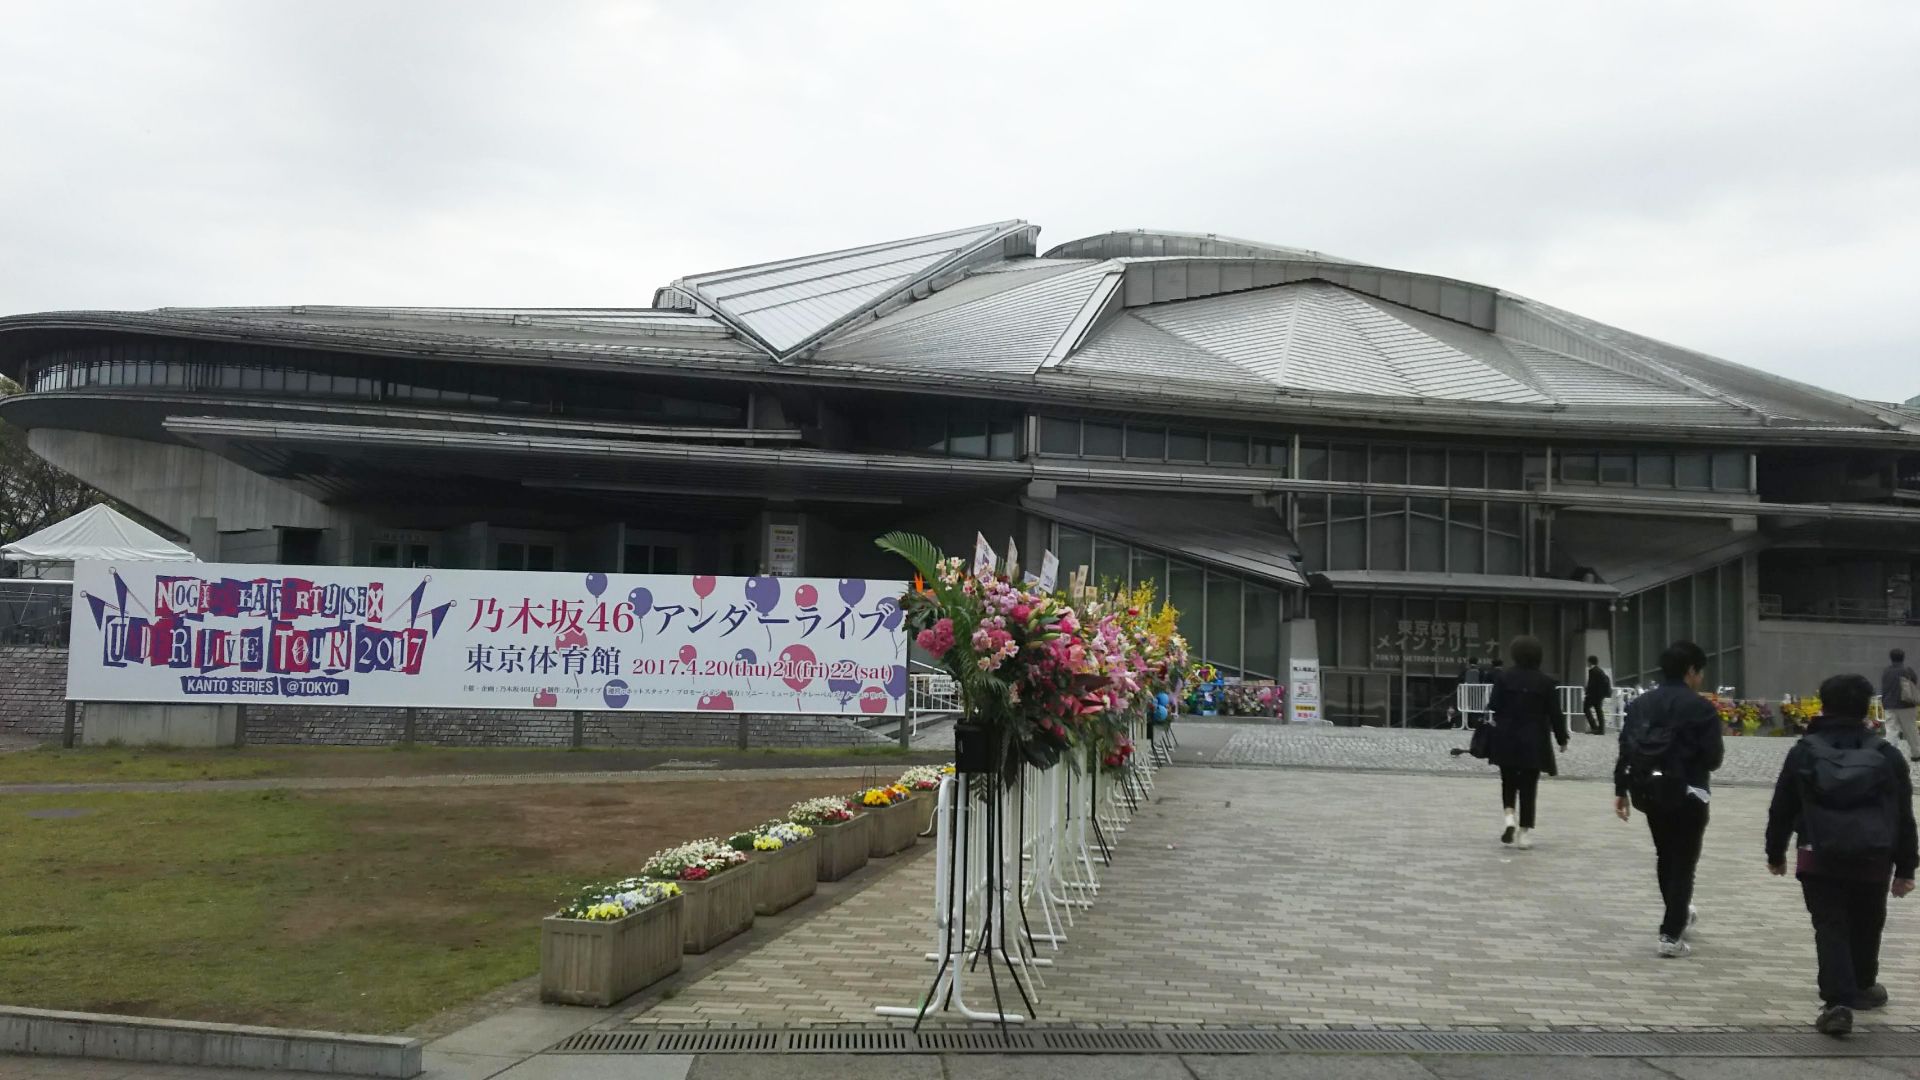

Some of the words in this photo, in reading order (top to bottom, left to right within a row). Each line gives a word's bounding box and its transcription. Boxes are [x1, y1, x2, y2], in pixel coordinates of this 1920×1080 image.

[466, 596, 635, 636] 乃木坂46
[652, 601, 897, 641] アンダーライブ
[1398, 620, 1479, 638] 東京体育館
[275, 629, 349, 670] TOUR
[359, 630, 426, 671] 2017
[1377, 635, 1500, 653] メインアリーナ
[466, 643, 622, 676] 東京体育館
[1403, 655, 1455, 663] METROPOLITAN
[187, 679, 228, 693] KANTO
[231, 680, 274, 694] SERIES
[286, 680, 339, 695] @TOKYO
